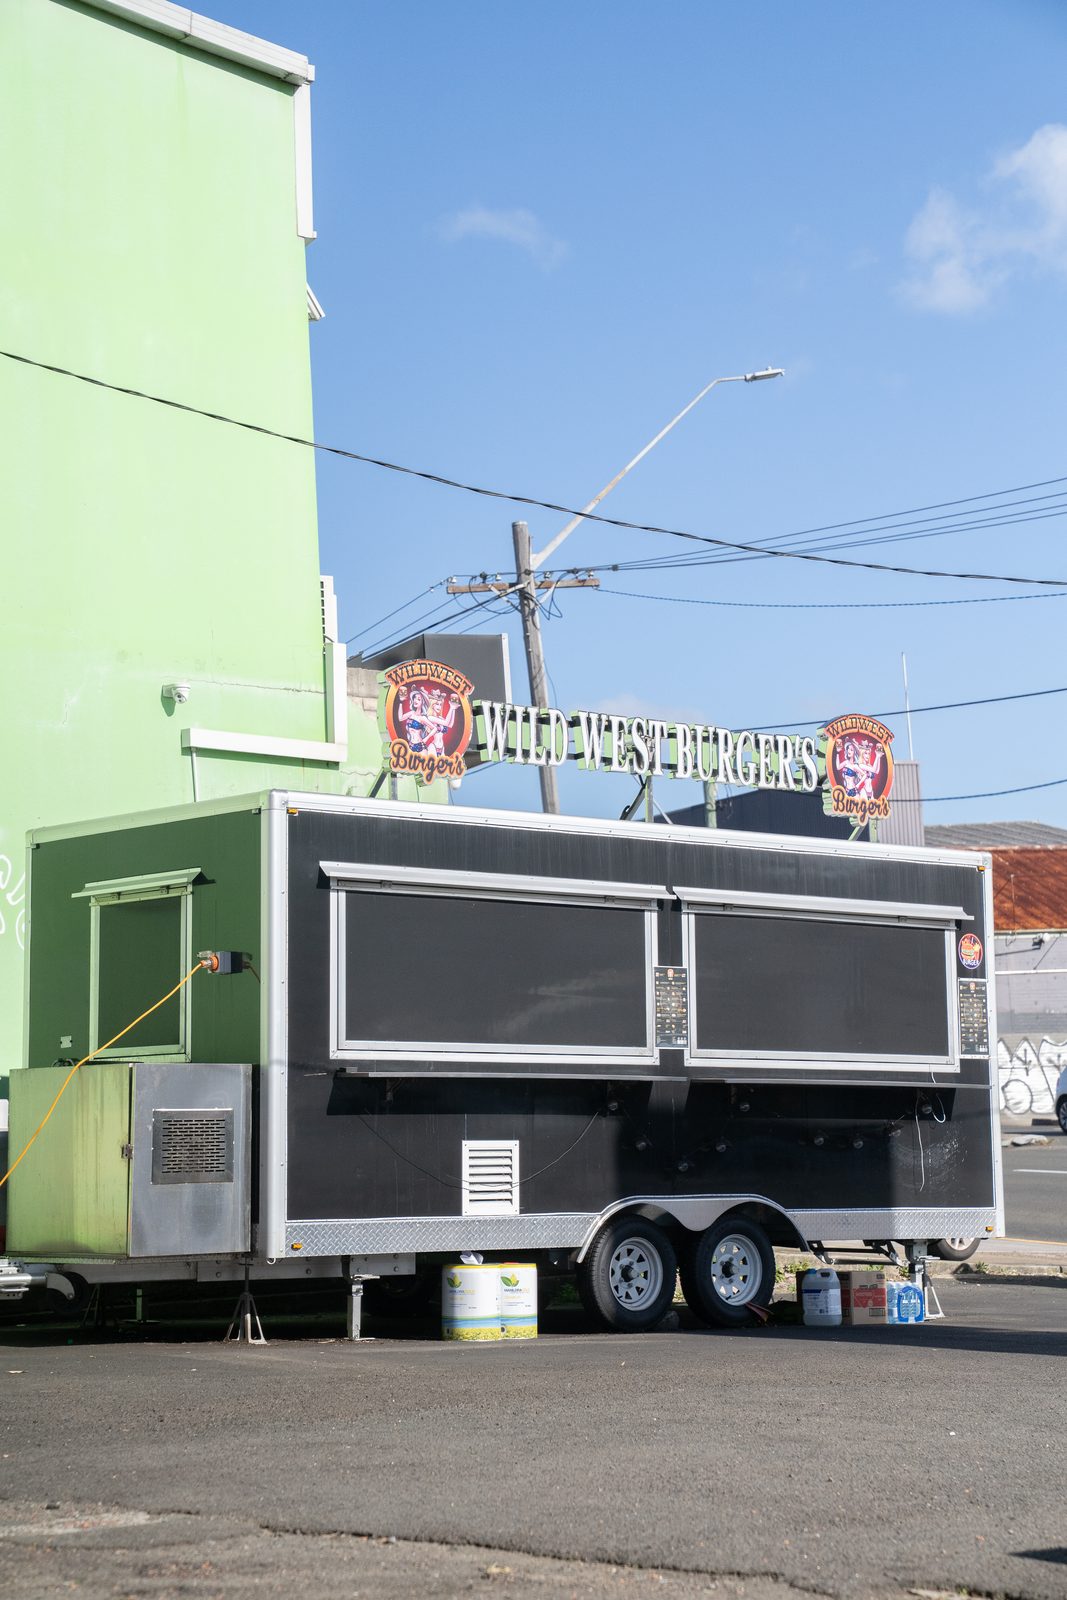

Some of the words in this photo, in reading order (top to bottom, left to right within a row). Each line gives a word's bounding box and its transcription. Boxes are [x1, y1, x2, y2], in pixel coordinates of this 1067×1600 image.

[391, 742, 465, 782] Burger's
[481, 701, 569, 766] WILD
[578, 711, 668, 776] WEST
[675, 722, 819, 792] BURGER'S
[832, 788, 890, 822] Burger's
